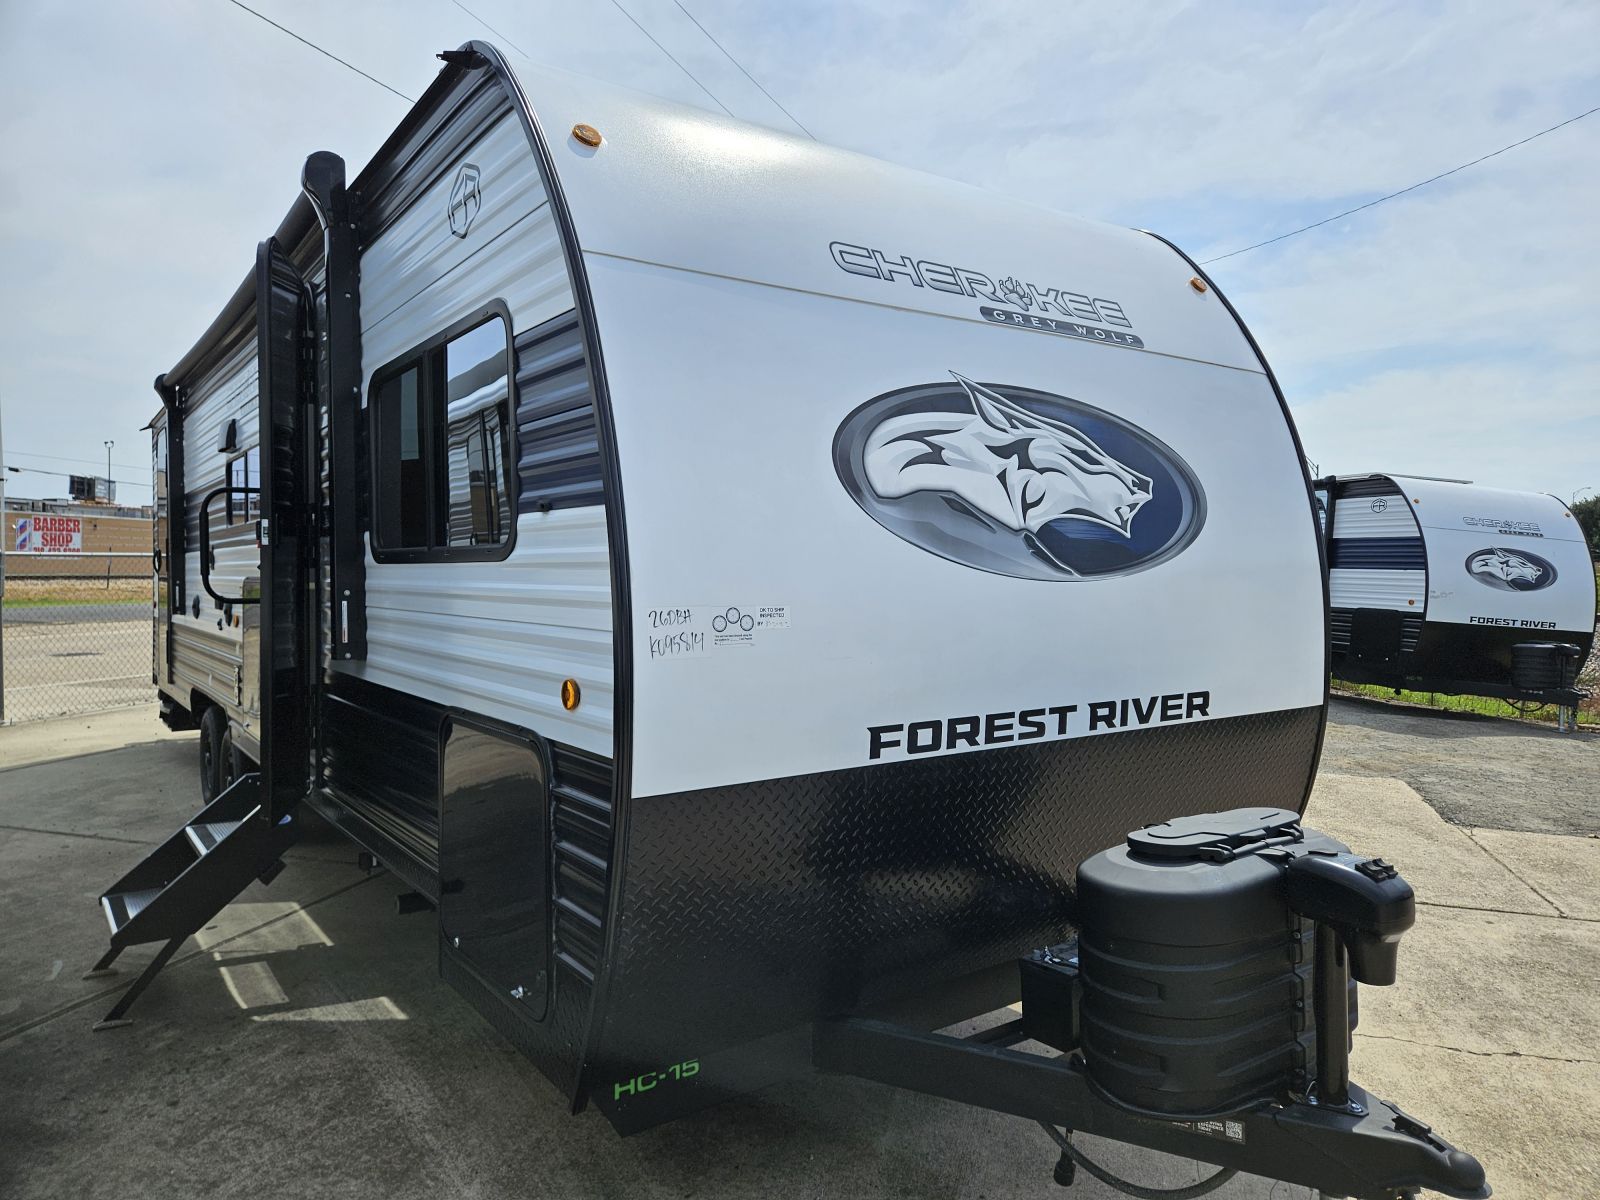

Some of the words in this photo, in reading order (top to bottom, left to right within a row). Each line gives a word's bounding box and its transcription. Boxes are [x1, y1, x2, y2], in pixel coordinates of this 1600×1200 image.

[993, 310, 1057, 330] GREY
[1074, 324, 1135, 345] WOLF
[33, 516, 81, 533] BARBER
[41, 532, 73, 547] SHOP
[1470, 616, 1518, 627] FOREST
[1521, 619, 1557, 630] RIVER
[867, 704, 1078, 760] FOREST
[1087, 690, 1210, 731] RIVER
[614, 1058, 700, 1101] HC-15
